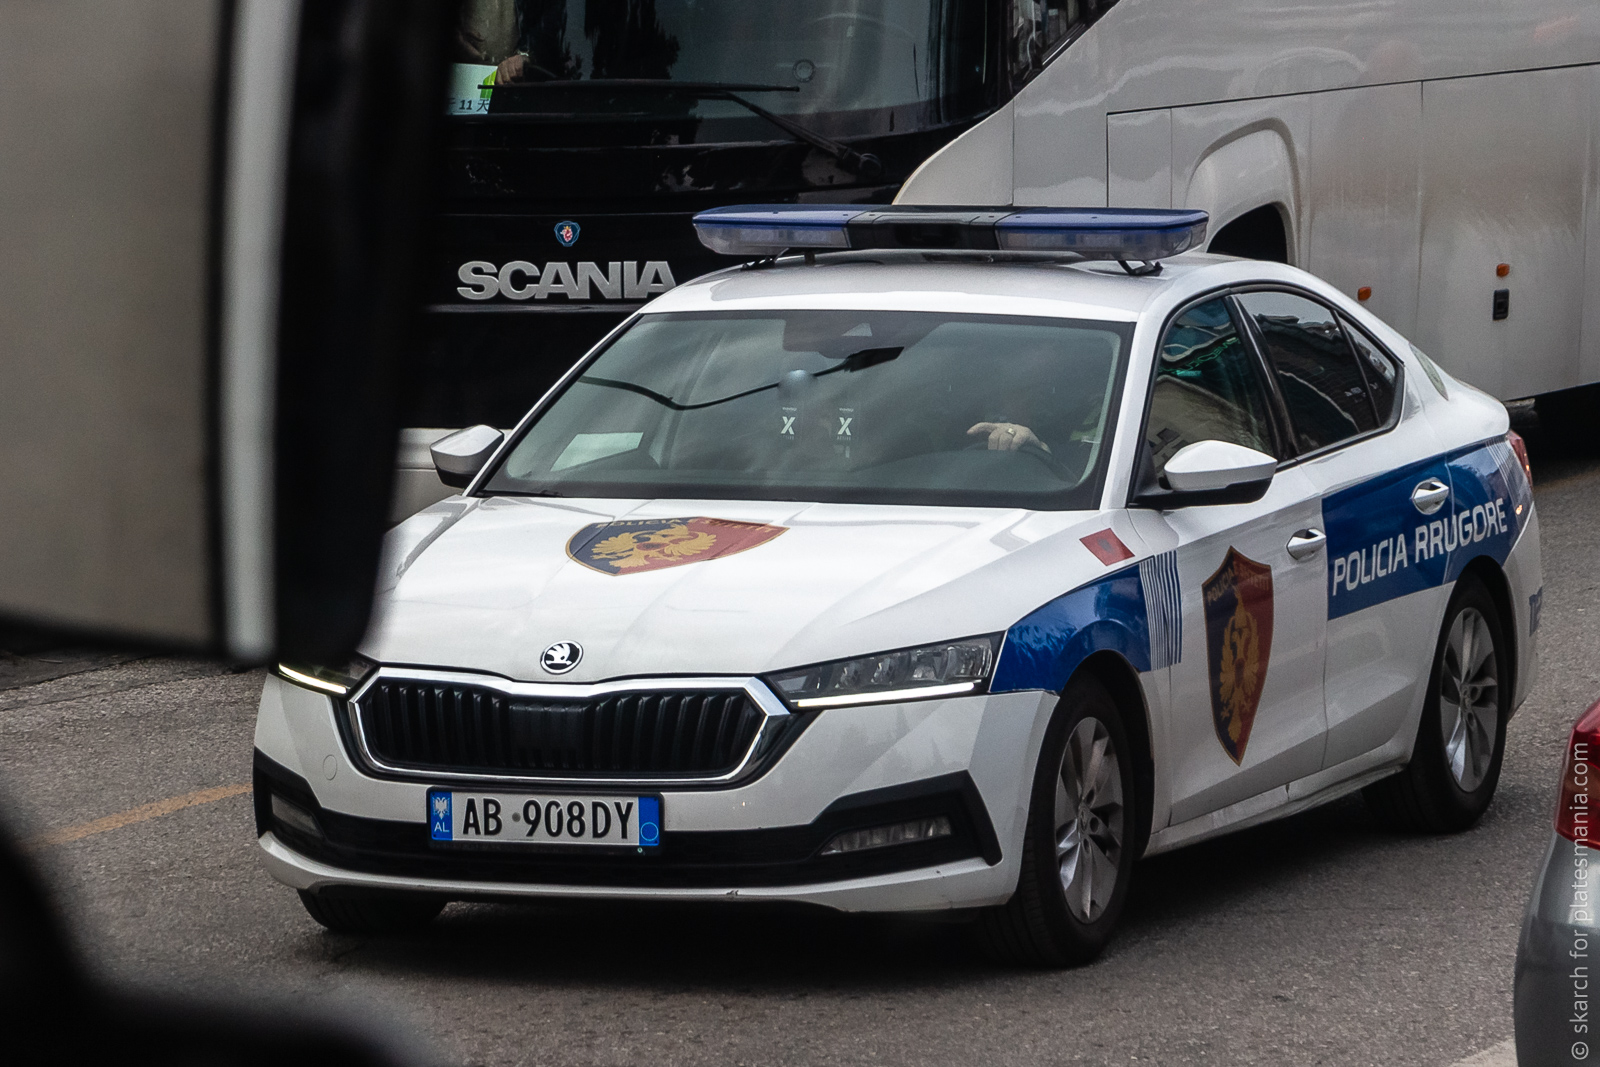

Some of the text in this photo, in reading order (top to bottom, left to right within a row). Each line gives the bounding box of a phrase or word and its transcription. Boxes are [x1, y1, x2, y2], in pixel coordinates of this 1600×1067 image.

[457, 260, 677, 300] SCANIA
[1332, 533, 1408, 597] POLICIA
[1415, 498, 1508, 564] RRUGORE
[434, 821, 450, 833] AL
[462, 797, 503, 837] AB
